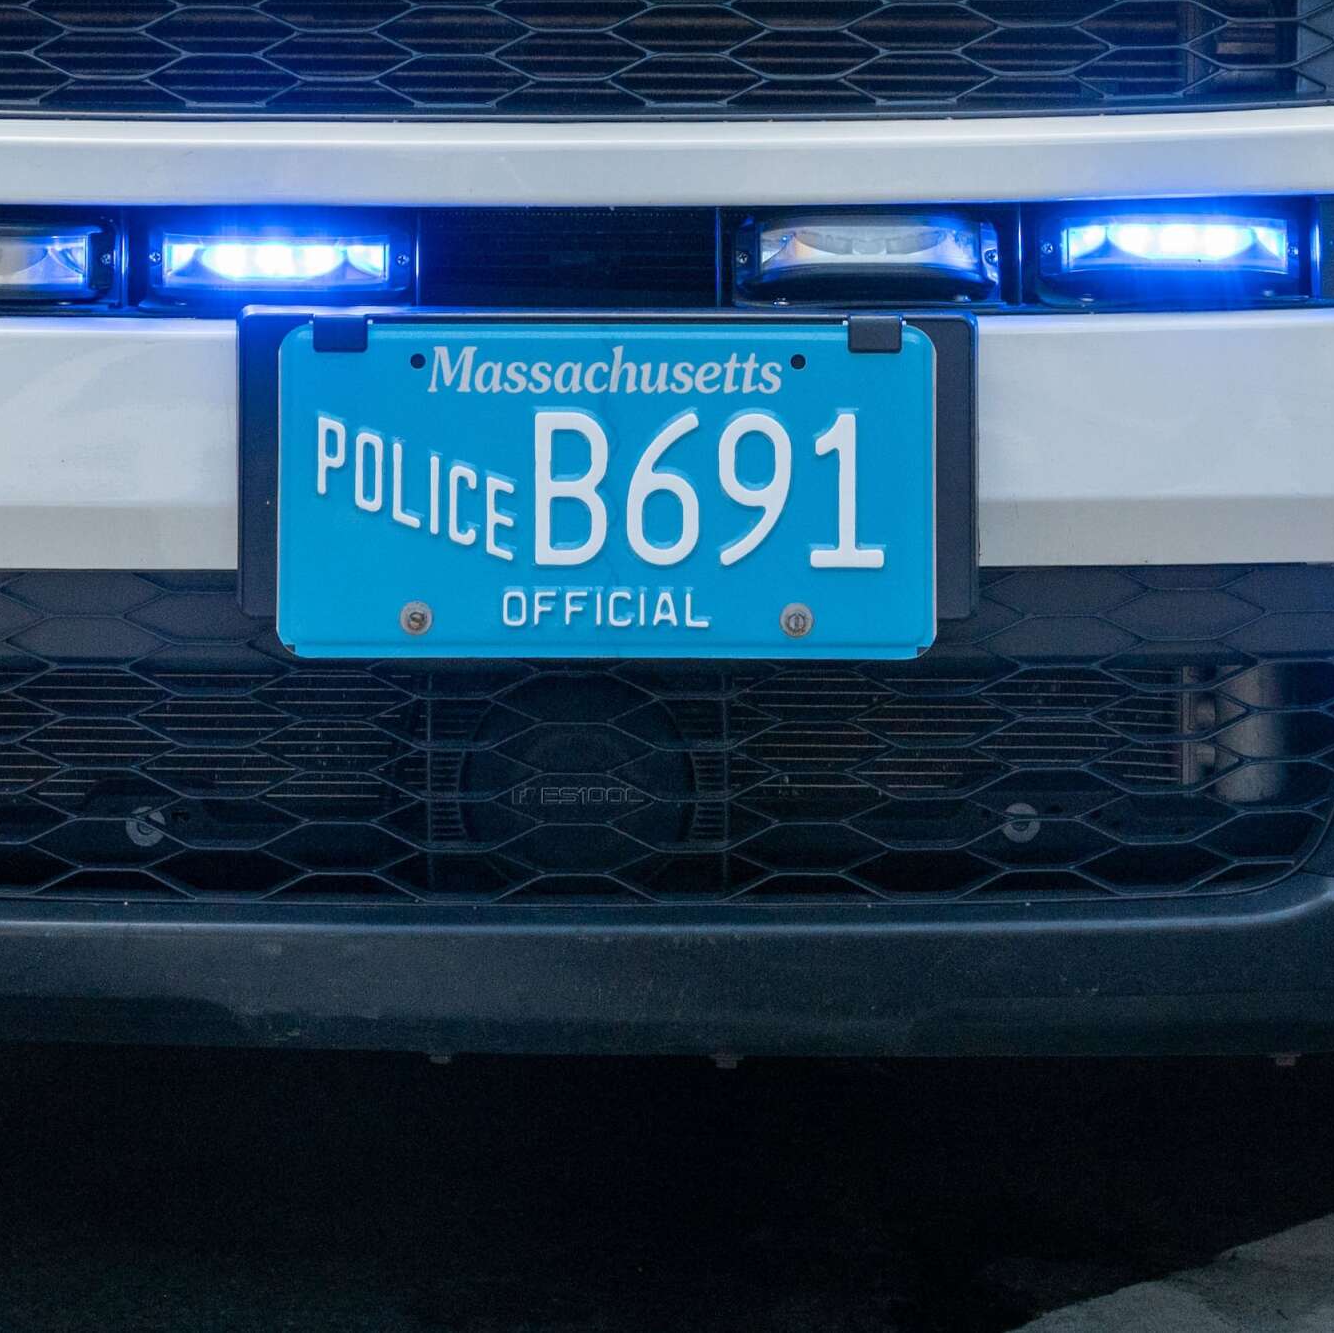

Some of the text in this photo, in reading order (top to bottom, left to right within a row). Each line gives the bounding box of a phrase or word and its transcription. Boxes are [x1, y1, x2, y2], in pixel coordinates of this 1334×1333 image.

[428, 345, 782, 395] Massachusetts
[316, 411, 886, 569] POLICE B691
[502, 590, 710, 629] OFFICIAL
